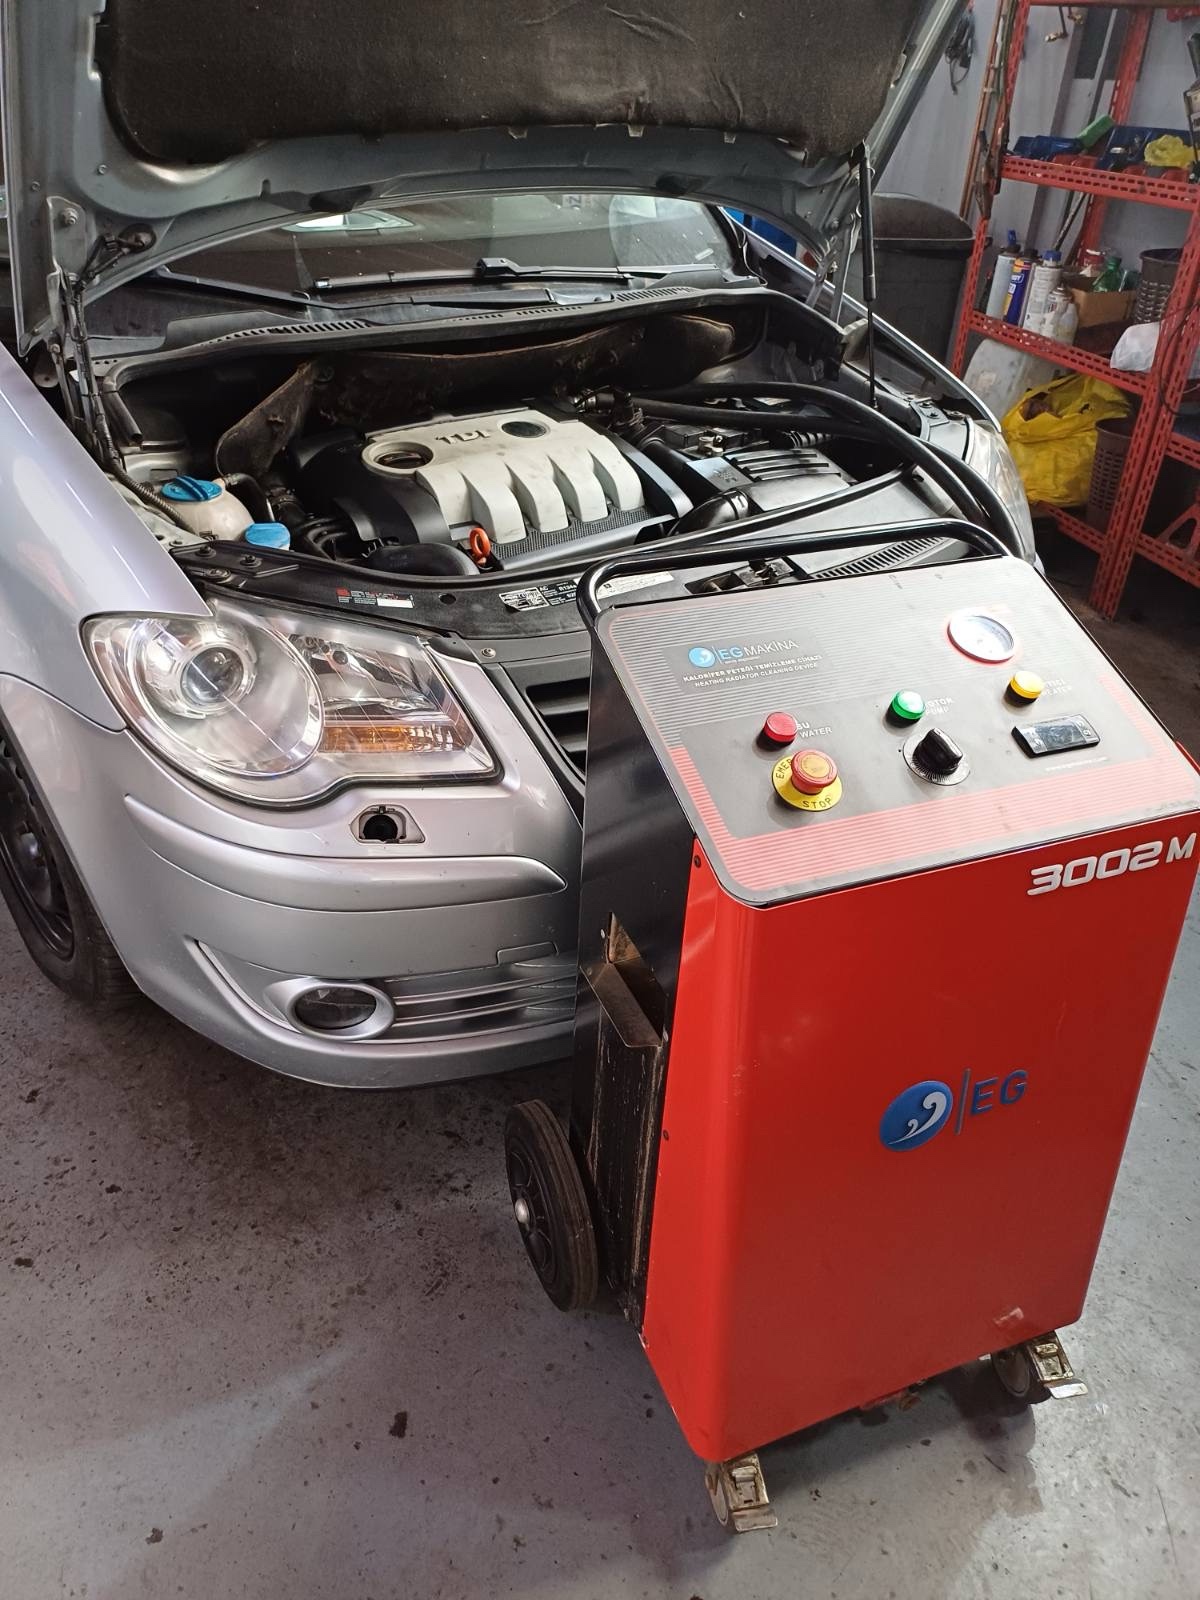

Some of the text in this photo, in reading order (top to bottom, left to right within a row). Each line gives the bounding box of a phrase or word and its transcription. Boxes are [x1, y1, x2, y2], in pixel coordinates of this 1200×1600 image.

[435, 430, 491, 445] TDI
[719, 646, 744, 660] EG
[695, 662, 818, 687] HEATING RADIATOR CLEANING DEVICE
[799, 726, 833, 738] WATER
[802, 797, 832, 809] STOP
[1027, 832, 1197, 896] 3002 M
[971, 1069, 1029, 1117] EG
